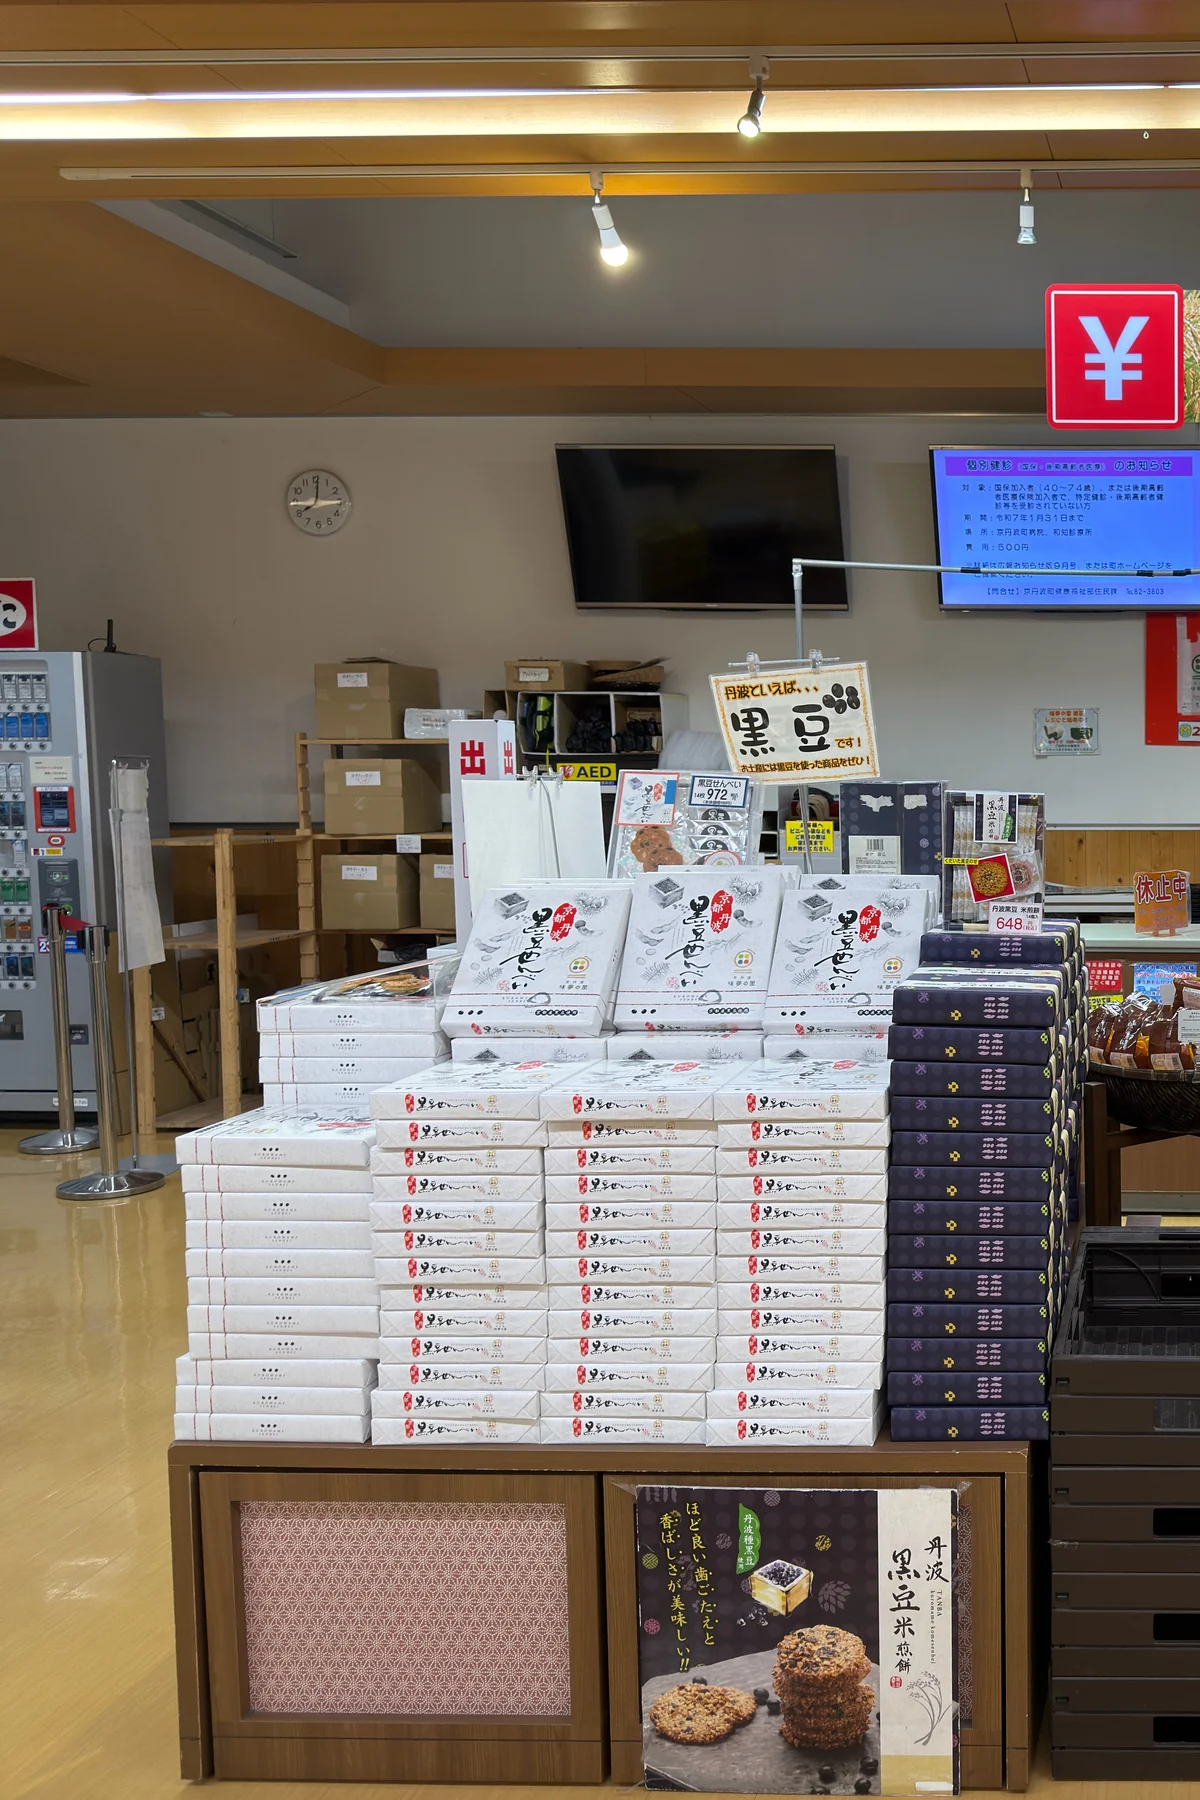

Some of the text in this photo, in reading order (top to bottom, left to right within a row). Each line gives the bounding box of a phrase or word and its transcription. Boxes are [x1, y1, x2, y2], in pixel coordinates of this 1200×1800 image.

[966, 460, 1012, 471] 個別健診
[1114, 460, 1172, 471] のお知らせ
[294, 487, 302, 495] 10
[332, 487, 338, 495] 2
[296, 510, 302, 518] 8
[316, 520, 321, 529] 6
[731, 704, 830, 757] 黒豆
[460, 740, 486, 775] 出
[741, 757, 870, 773] お土産には黒豆を使った商品をぜひ！
[577, 766, 611, 778] AED
[698, 778, 742, 789] 黒豆せんべい
[707, 788, 728, 801] 972
[1135, 874, 1187, 905] 休止中
[992, 905, 1040, 914] 丹波黒豆 米煎餅
[996, 917, 1023, 930] 648
[743, 1513, 754, 1567] 丹波種黒豆
[924, 1536, 949, 1583] 丹波
[686, 1502, 715, 1646] ほど良い歯ごたえと
[660, 1513, 690, 1672] 香ばしさが美味しい!!
[887, 1548, 921, 1674] 黒豆米煎餅
